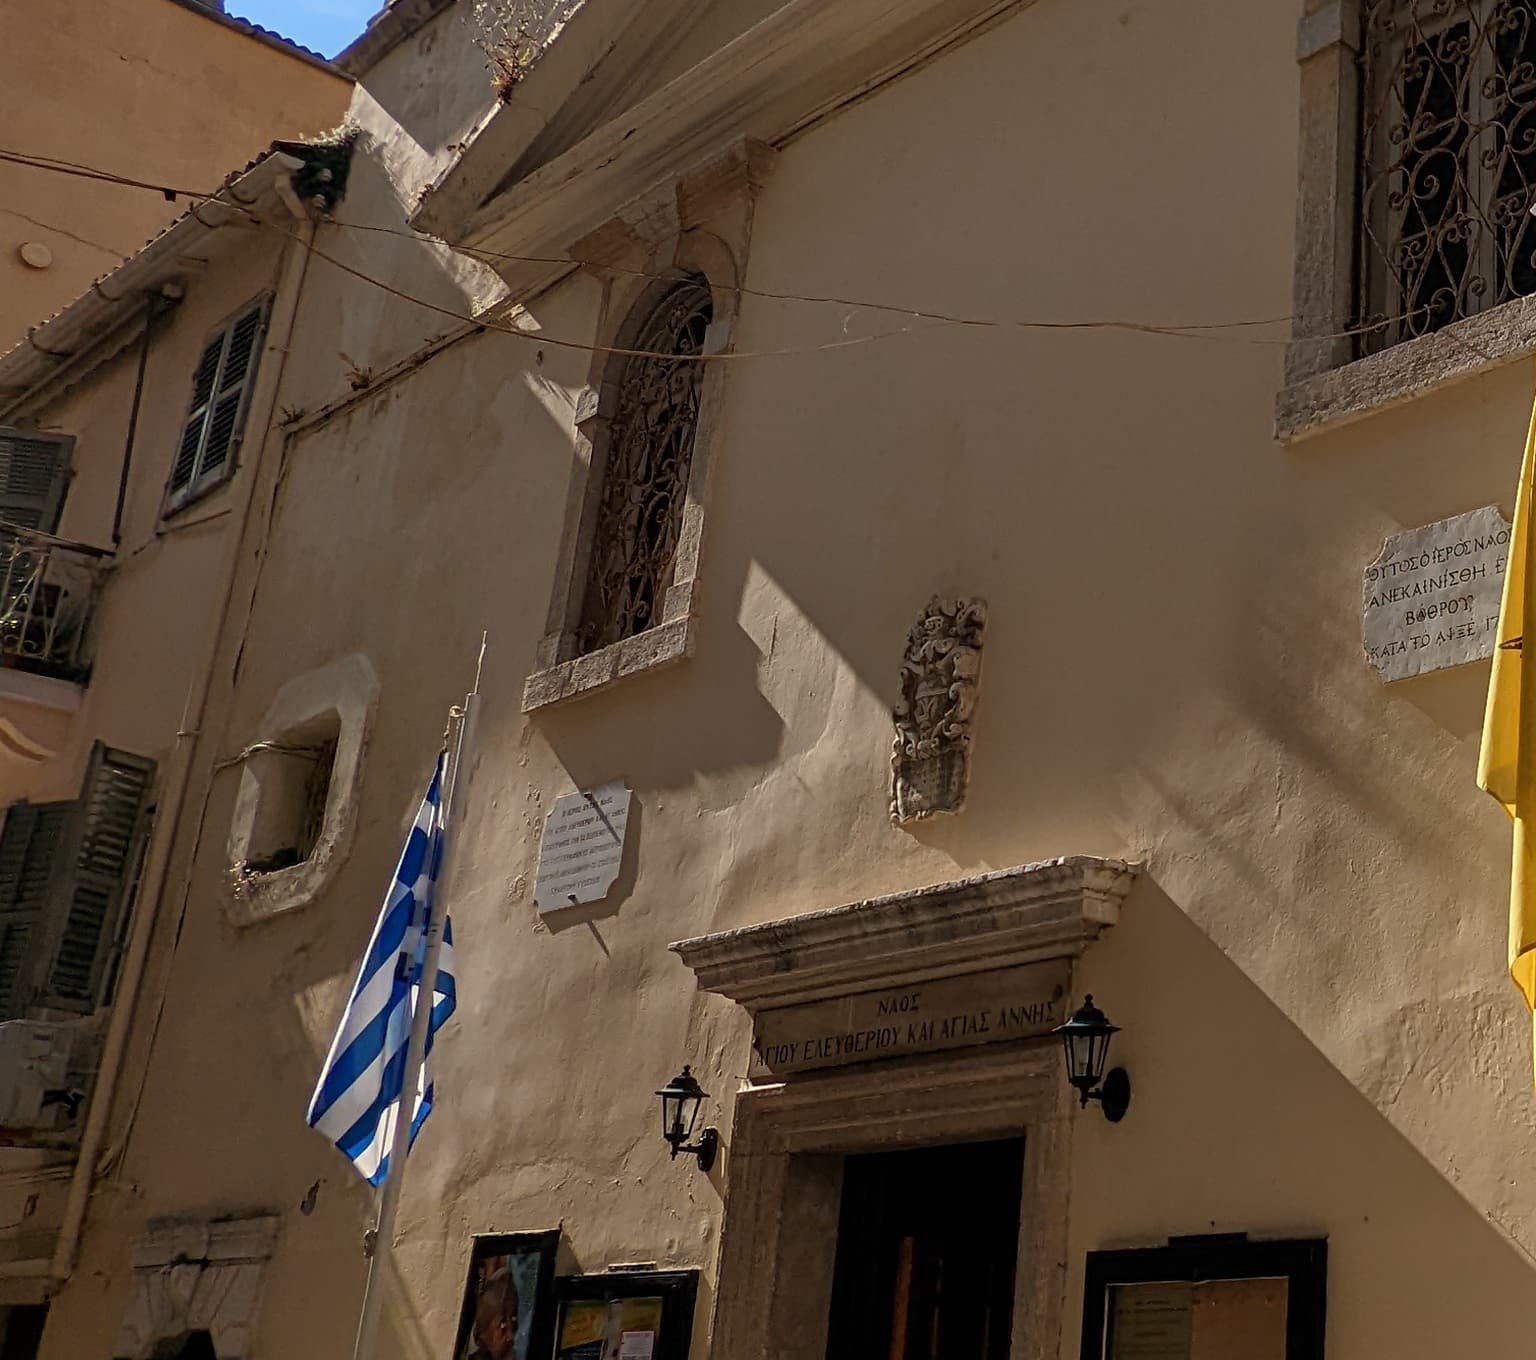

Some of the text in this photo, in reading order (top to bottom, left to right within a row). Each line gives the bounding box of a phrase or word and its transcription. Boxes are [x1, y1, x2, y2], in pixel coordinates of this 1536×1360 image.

[1474, 529, 1512, 551] ΝΑΟ
[877, 992, 921, 1017] ΝΑΟΣ
[756, 1000, 1057, 1067] ΑΓΙΟΥ ΕΛΕΥΘΕΡΙΟΥ ΚΑΙ ΑΓΙΑΣ ΑΝΝΗΣ
